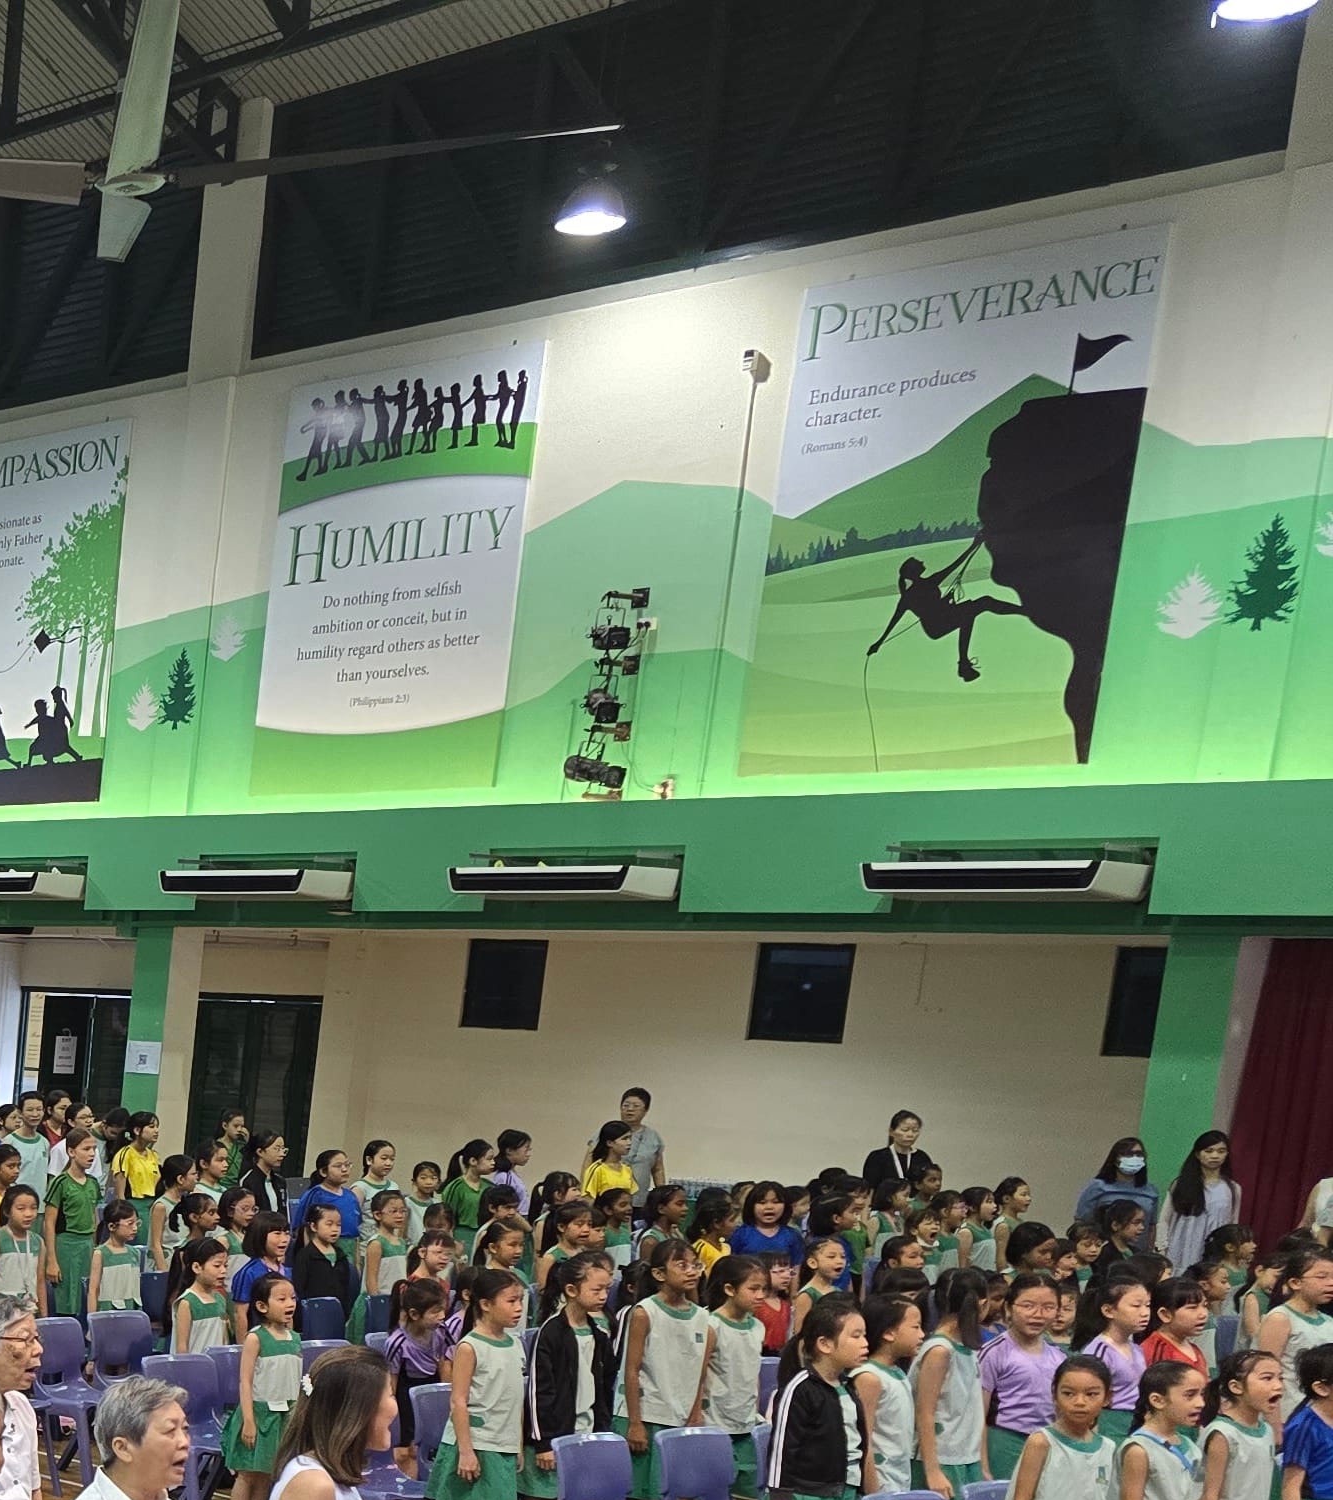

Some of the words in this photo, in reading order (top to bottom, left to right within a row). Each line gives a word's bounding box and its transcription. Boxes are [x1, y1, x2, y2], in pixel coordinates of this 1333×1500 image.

[802, 254, 1164, 362] PERSEVERANCE
[807, 381, 896, 406] Endurance
[899, 367, 978, 396] produces
[805, 406, 882, 428] character.
[800, 439, 847, 456] (Romans
[848, 435, 869, 450] 5:4)
[32, 513, 43, 525] as
[14, 533, 44, 547] Father
[282, 505, 517, 587] HUMILITY
[323, 595, 341, 609] Do
[343, 590, 390, 607] nothing
[391, 587, 421, 603] from
[424, 580, 462, 598] selfish
[312, 619, 364, 635] ambition
[366, 617, 380, 630] or
[382, 612, 428, 629] conceit,
[431, 608, 452, 624] but
[455, 607, 468, 621] in
[296, 644, 346, 662] humility
[347, 640, 384, 660] regard
[387, 636, 425, 653] others
[427, 636, 441, 650] as
[443, 632, 481, 648] better
[336, 667, 363, 683] than
[365, 663, 430, 684] yourselves.
